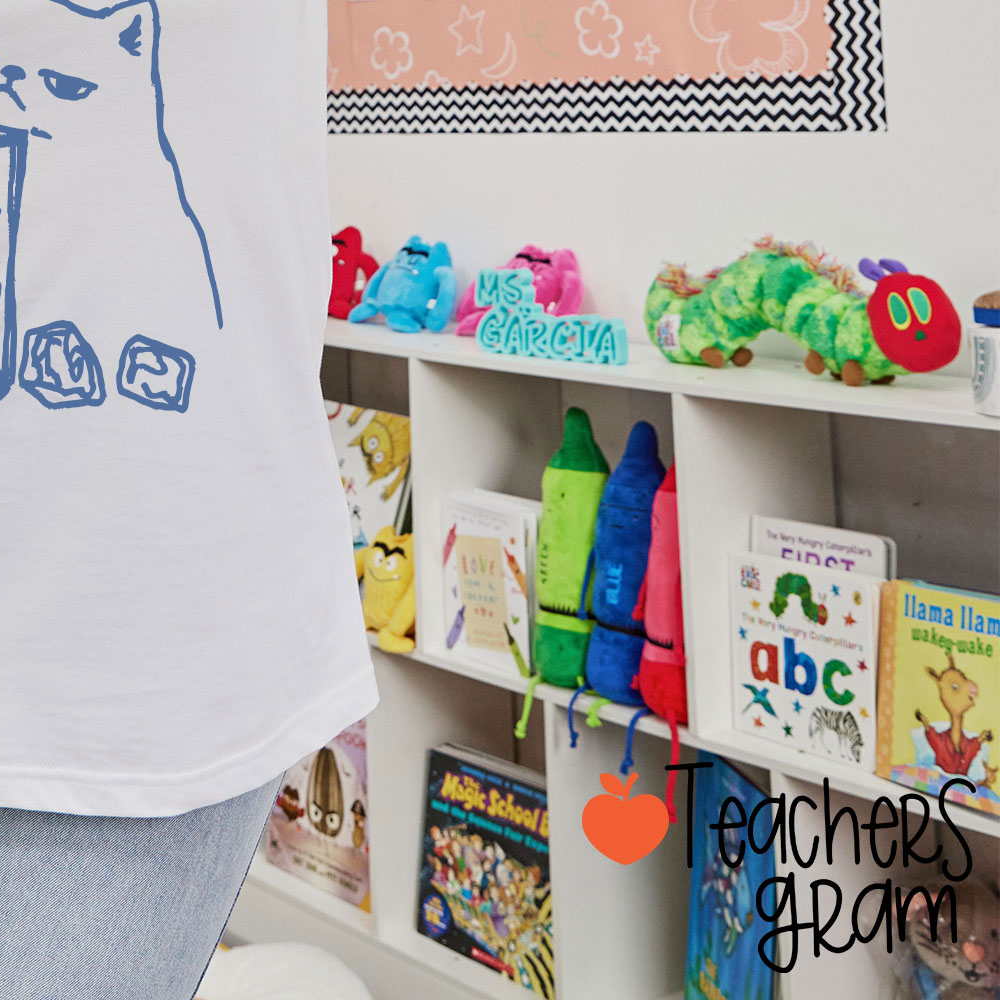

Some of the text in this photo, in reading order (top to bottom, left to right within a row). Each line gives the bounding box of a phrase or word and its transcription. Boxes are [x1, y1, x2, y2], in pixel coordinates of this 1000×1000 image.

[477, 271, 524, 306] MS
[479, 311, 618, 363] GARCIA
[904, 593, 954, 628] llama
[911, 627, 993, 657] wakey-wake
[750, 636, 856, 707] abc
[440, 771, 486, 810] Magic
[487, 788, 539, 832] School
